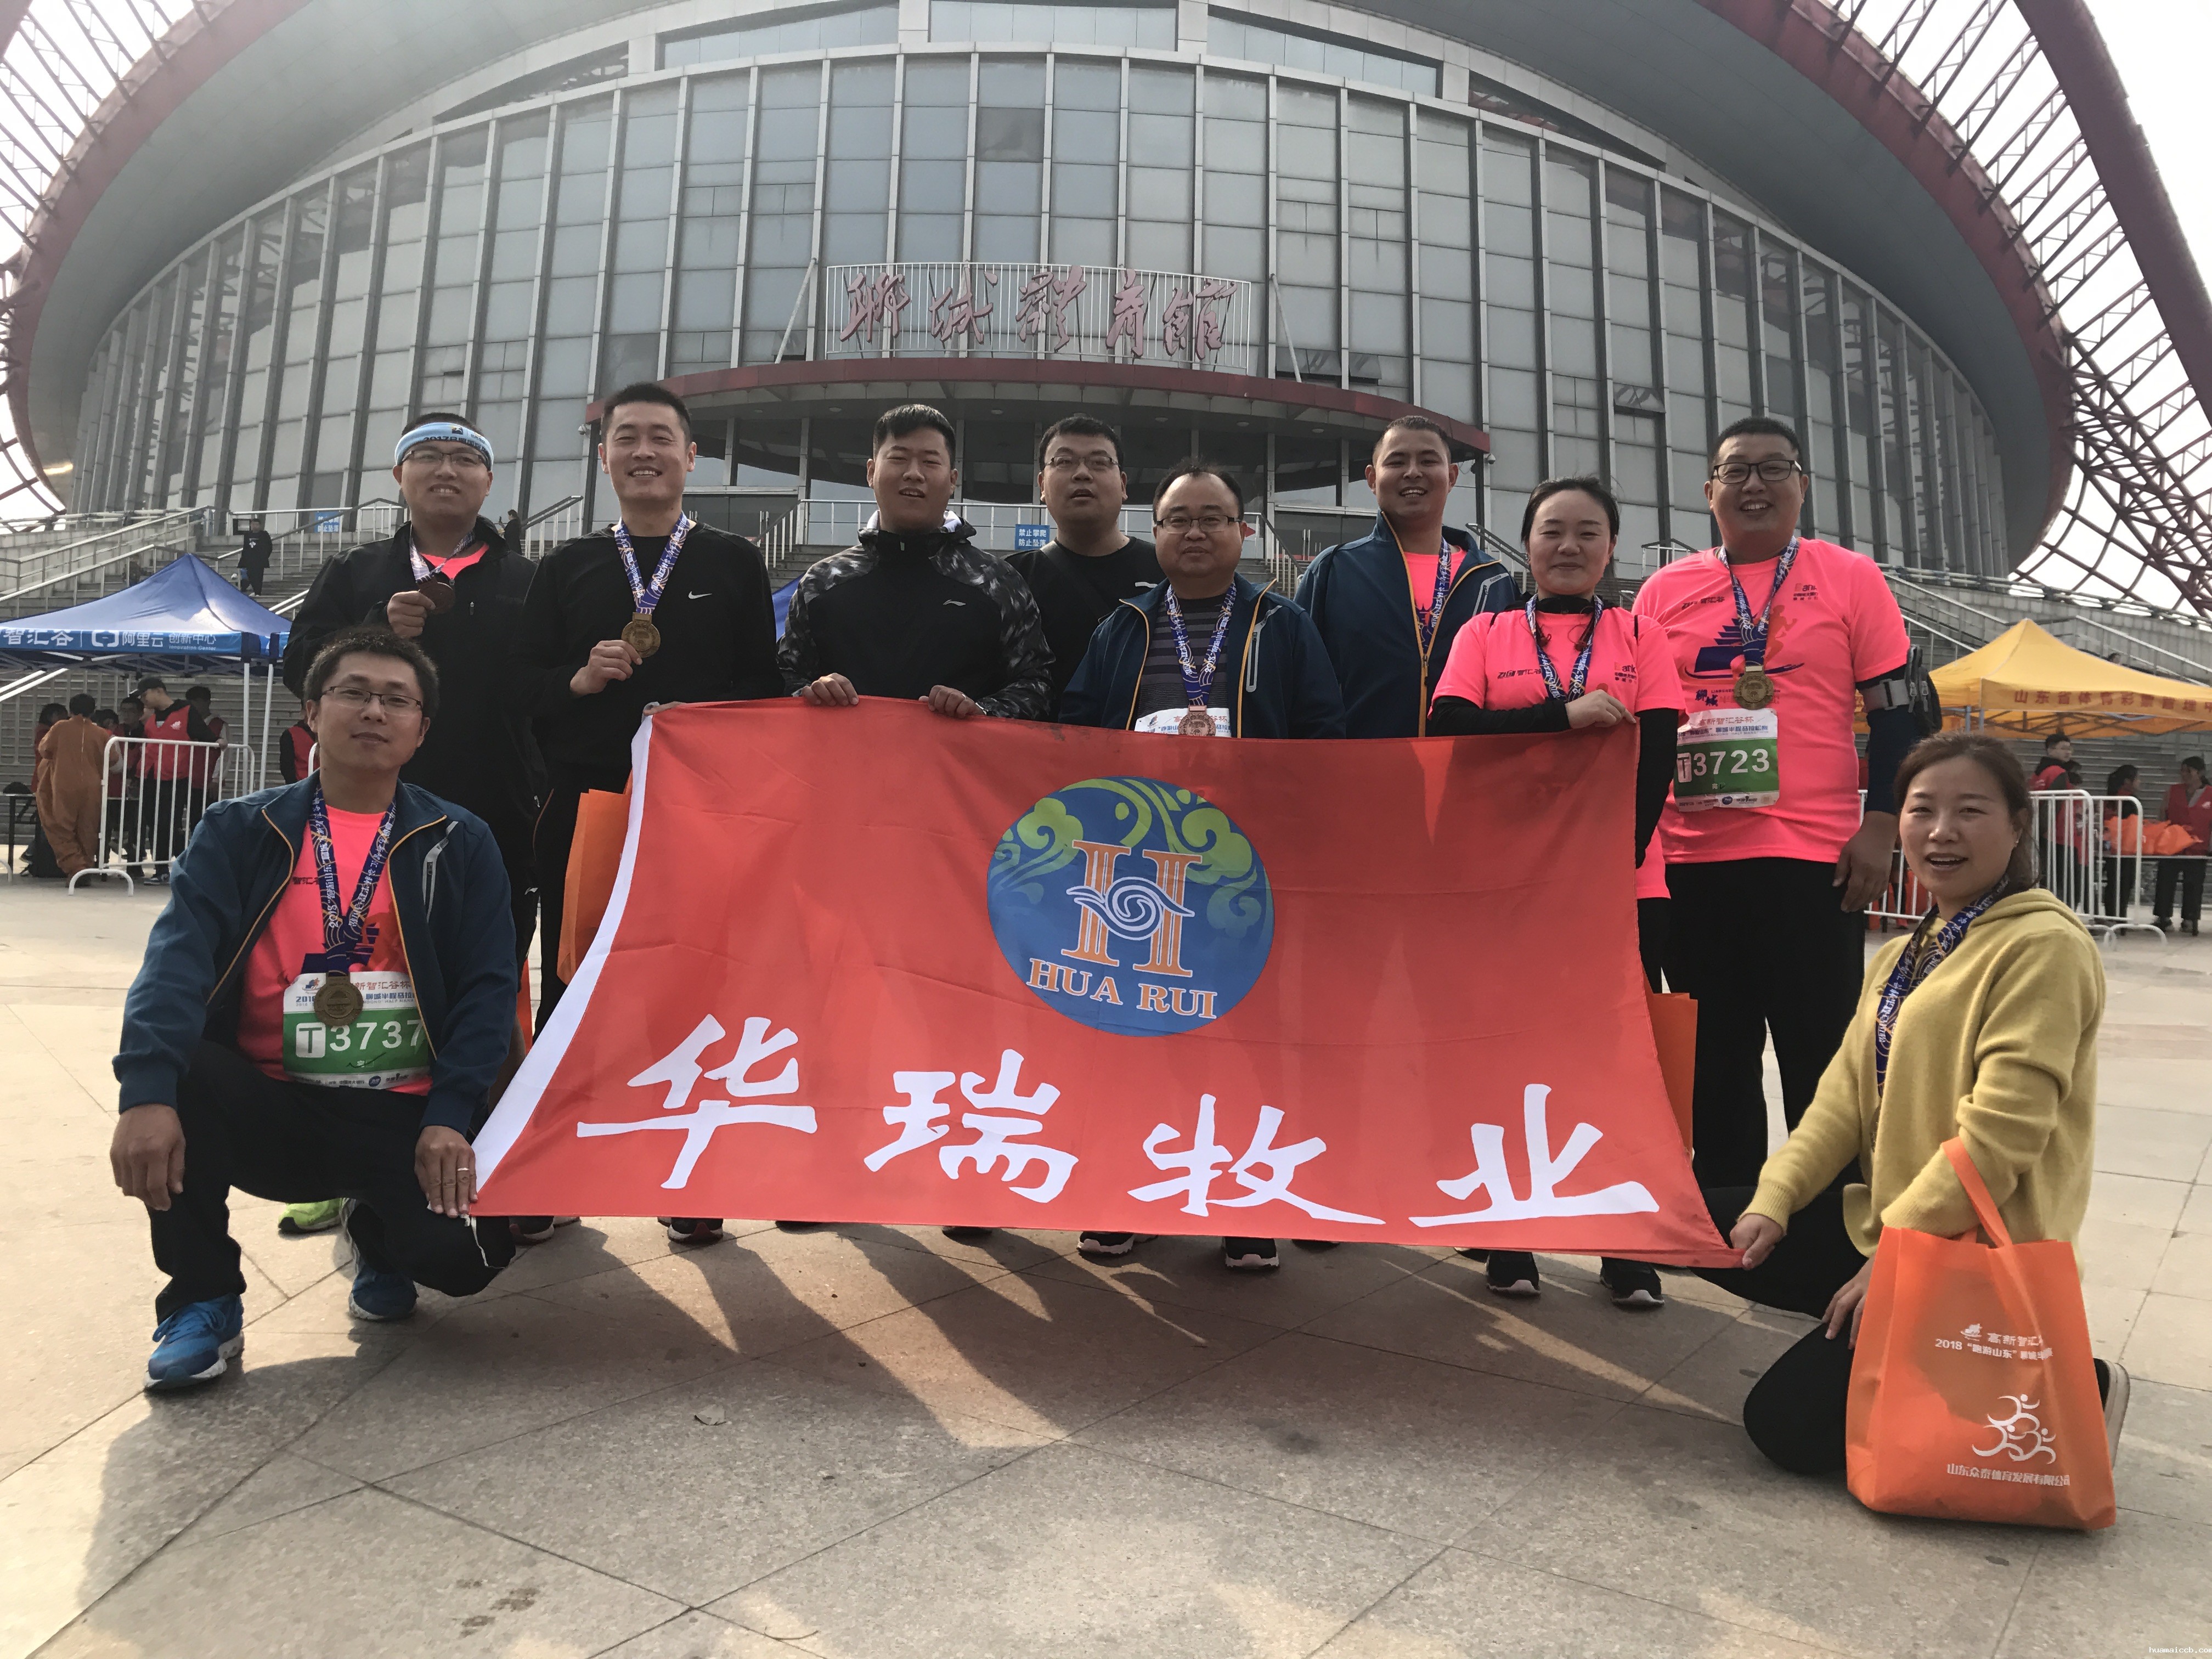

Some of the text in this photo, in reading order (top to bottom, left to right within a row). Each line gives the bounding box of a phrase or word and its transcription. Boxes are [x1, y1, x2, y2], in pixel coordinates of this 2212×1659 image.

[3, 629, 217, 647] 智汇谷 阿里云 创新中心
[1026, 958, 1217, 1019] HUA RUI
[576, 1012, 1661, 1229] 华瑞牧业
[1935, 1339, 1963, 1350] 2018
